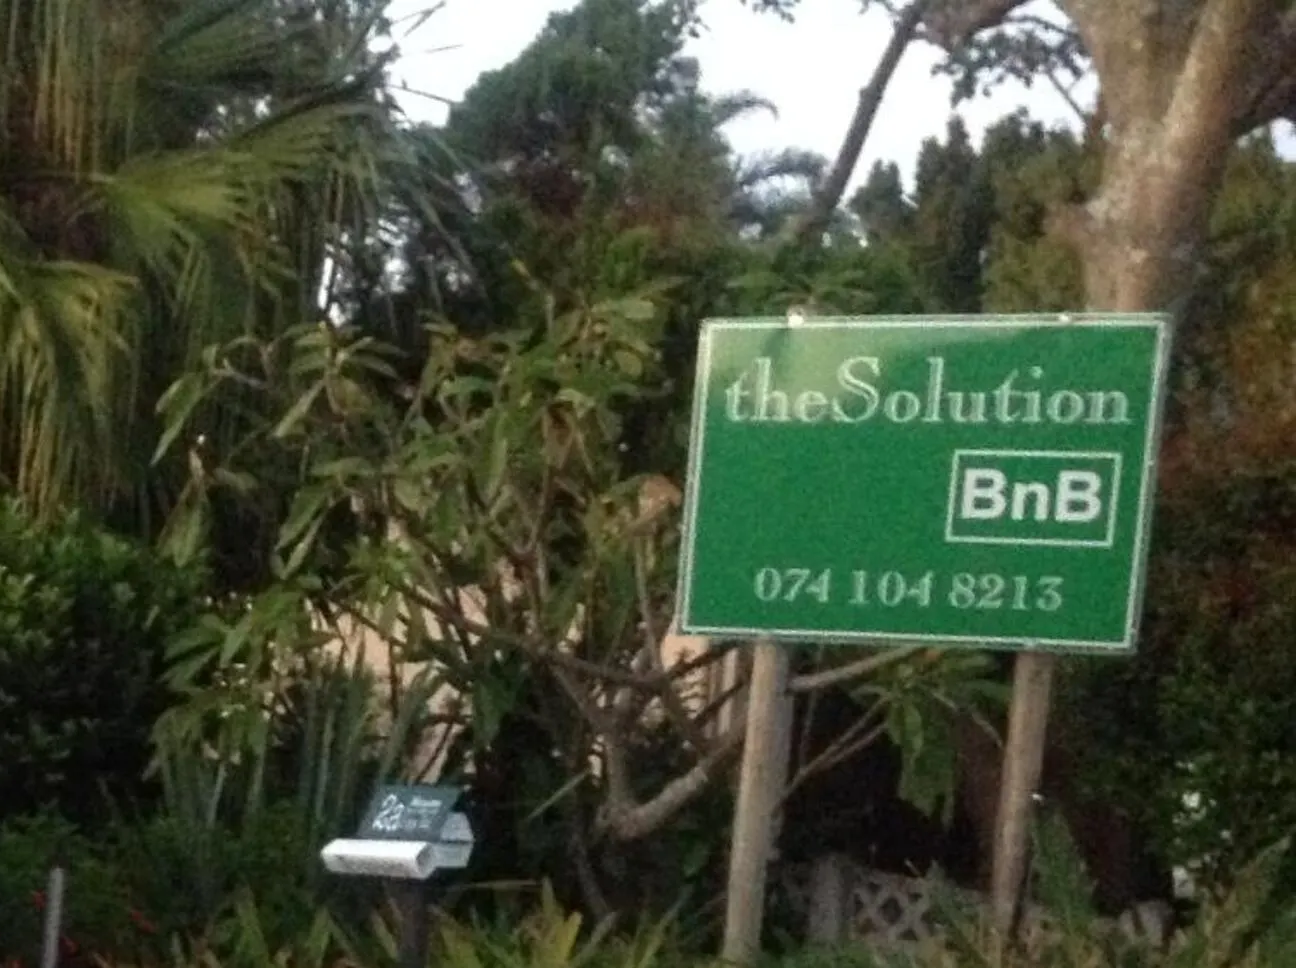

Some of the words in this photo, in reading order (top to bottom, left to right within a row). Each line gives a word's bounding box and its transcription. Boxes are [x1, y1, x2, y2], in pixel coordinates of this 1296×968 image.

[960, 468, 1102, 523] BnB
[754, 567, 830, 604] 074
[850, 571, 935, 607] 104
[948, 573, 1063, 611] 8213
